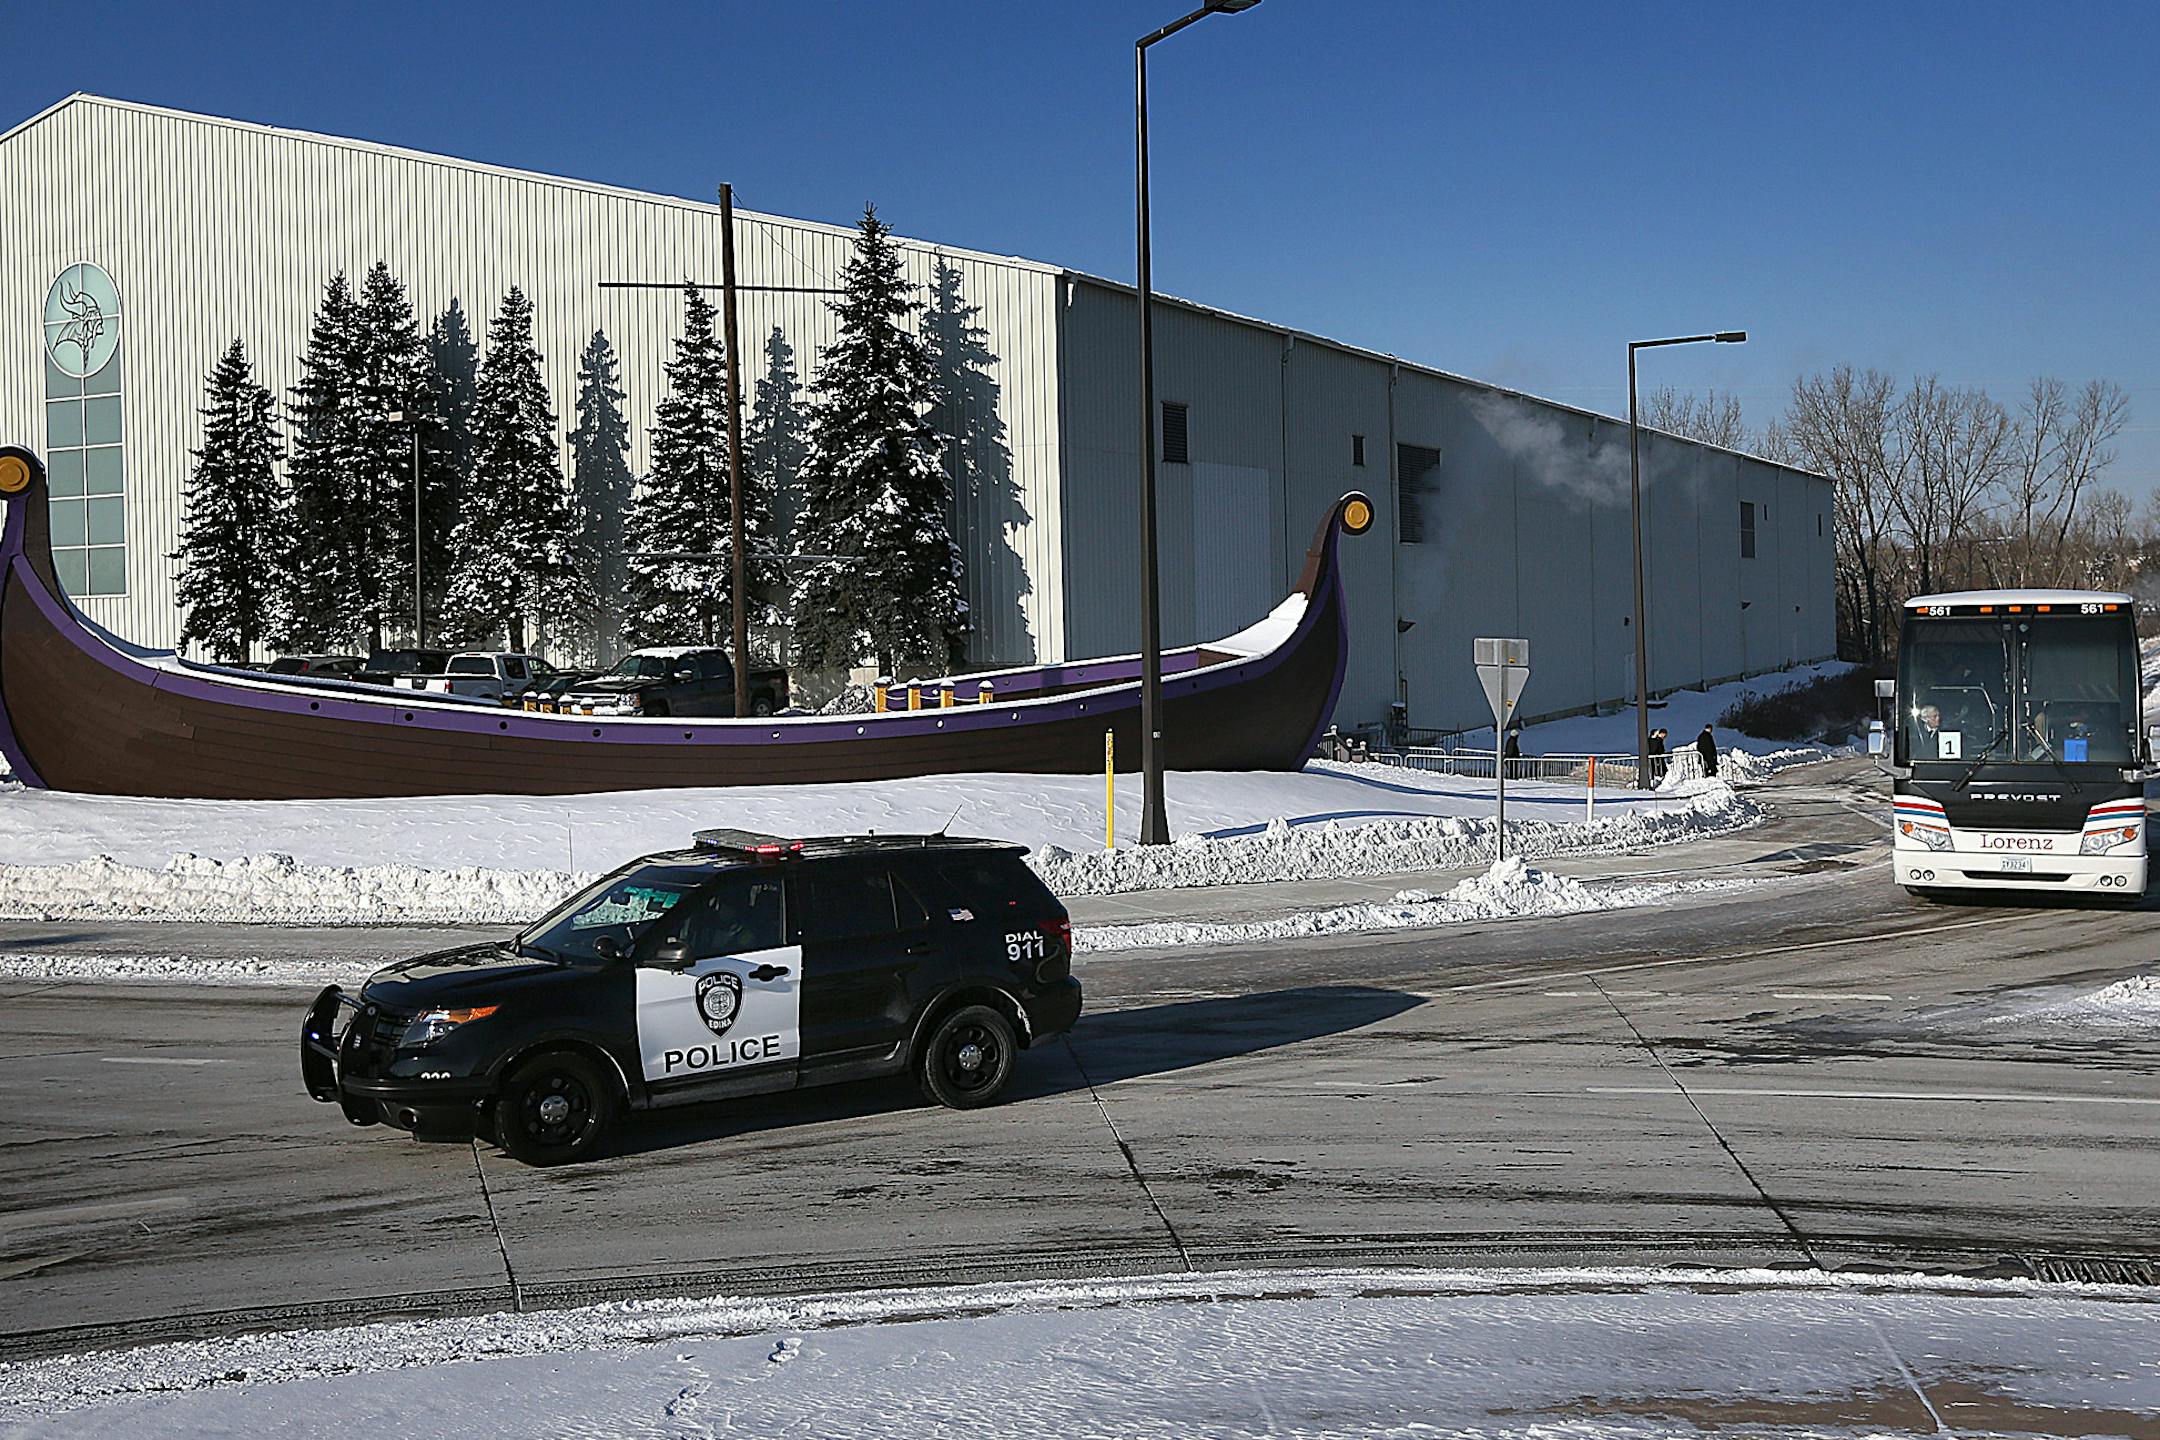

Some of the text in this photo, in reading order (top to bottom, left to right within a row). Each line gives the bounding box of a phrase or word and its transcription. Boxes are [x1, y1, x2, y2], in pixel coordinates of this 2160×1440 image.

[1929, 606, 1951, 616] 561
[2081, 604, 2104, 614] 561
[1945, 741, 1955, 755] 1
[1970, 793, 2061, 802] PREVOST
[1980, 833, 2053, 850] Lorenz
[1005, 930, 1043, 944] DIAL
[1007, 940, 1044, 961] 911
[698, 975, 739, 995] POLICE
[708, 1018, 732, 1029] EDINA
[664, 1035, 781, 1073] POLICE
